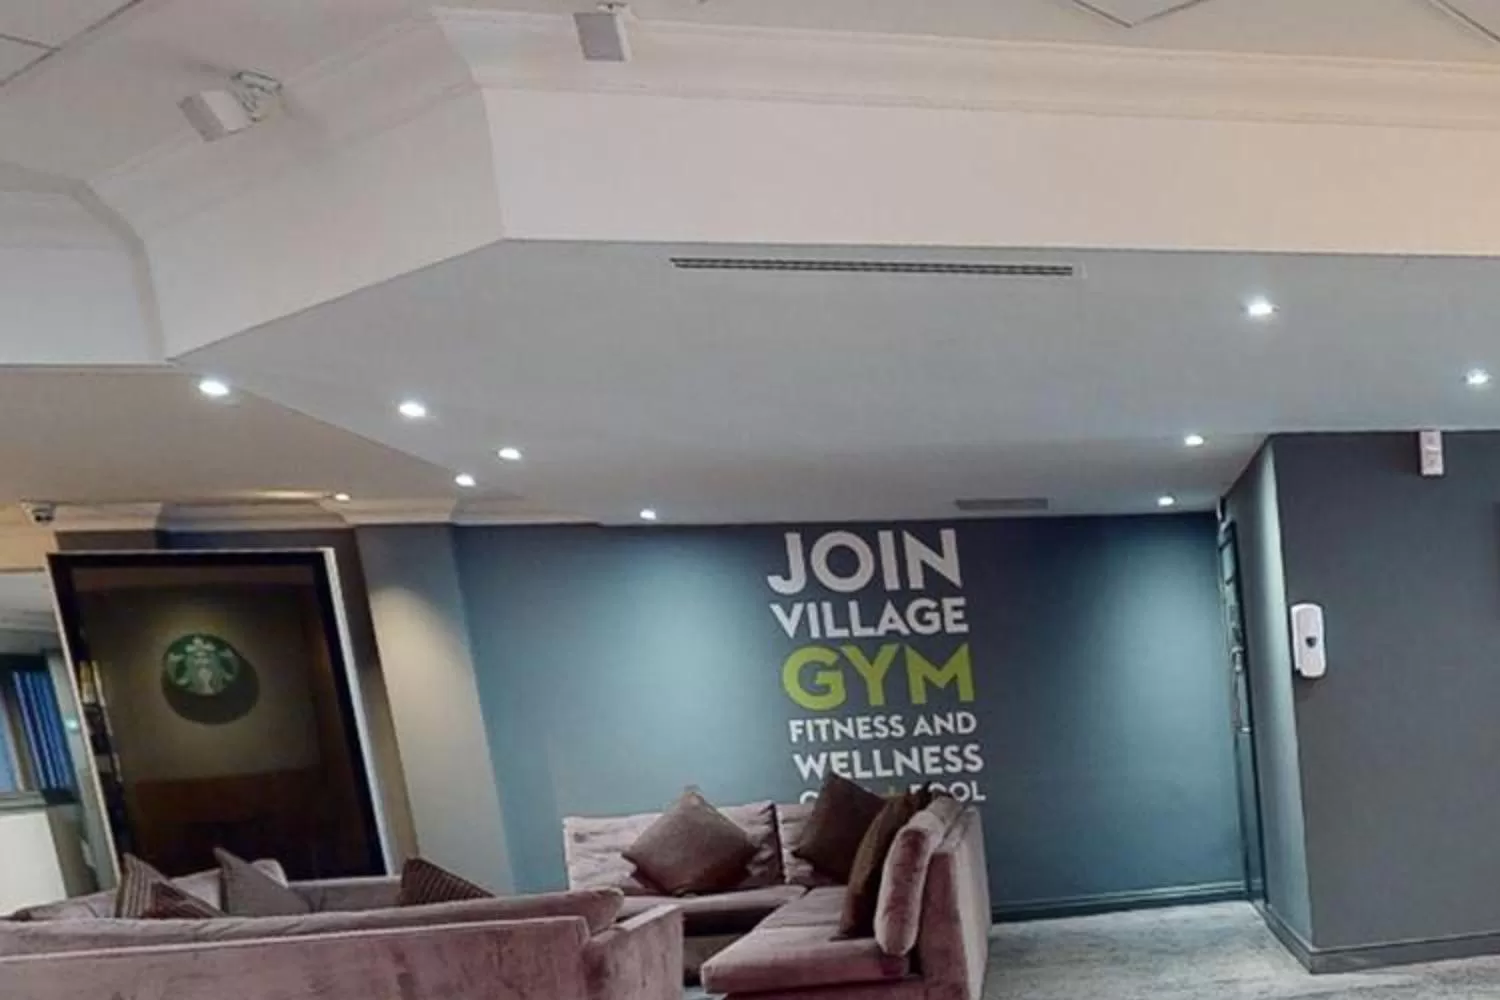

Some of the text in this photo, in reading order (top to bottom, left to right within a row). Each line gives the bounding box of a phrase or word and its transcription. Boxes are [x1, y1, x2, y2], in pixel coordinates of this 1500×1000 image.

[767, 528, 962, 594] JOIN
[769, 597, 969, 639] VILLAGE
[783, 643, 976, 711] GYM
[788, 712, 977, 743] FITNESS AND
[793, 744, 984, 781] WELLNESS
